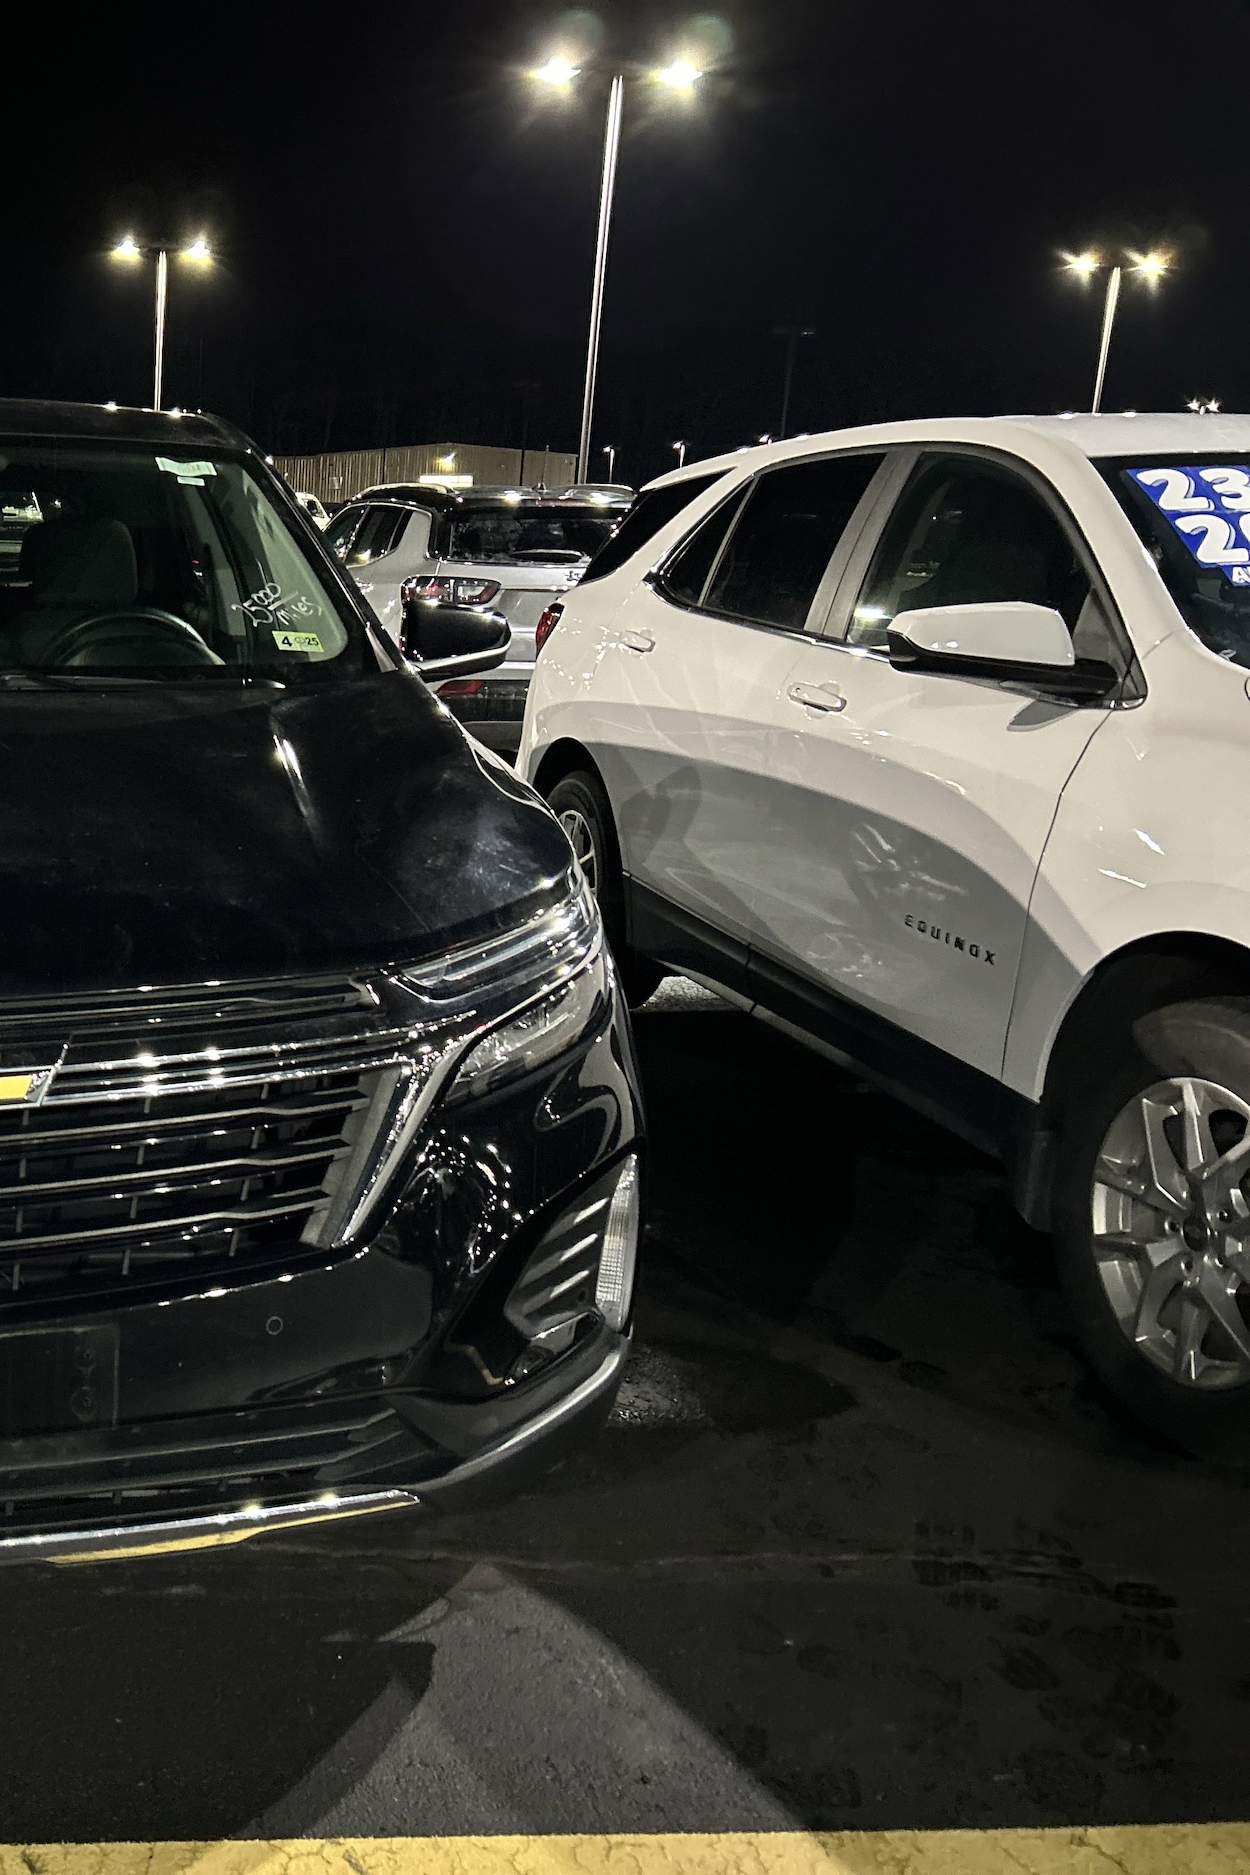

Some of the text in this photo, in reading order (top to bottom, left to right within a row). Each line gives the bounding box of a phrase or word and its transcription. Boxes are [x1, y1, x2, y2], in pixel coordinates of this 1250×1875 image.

[1136, 468, 1250, 511] 23
[1175, 514, 1250, 565] 2
[281, 636, 319, 647] 4 25
[904, 914, 996, 966] EQUINOX
